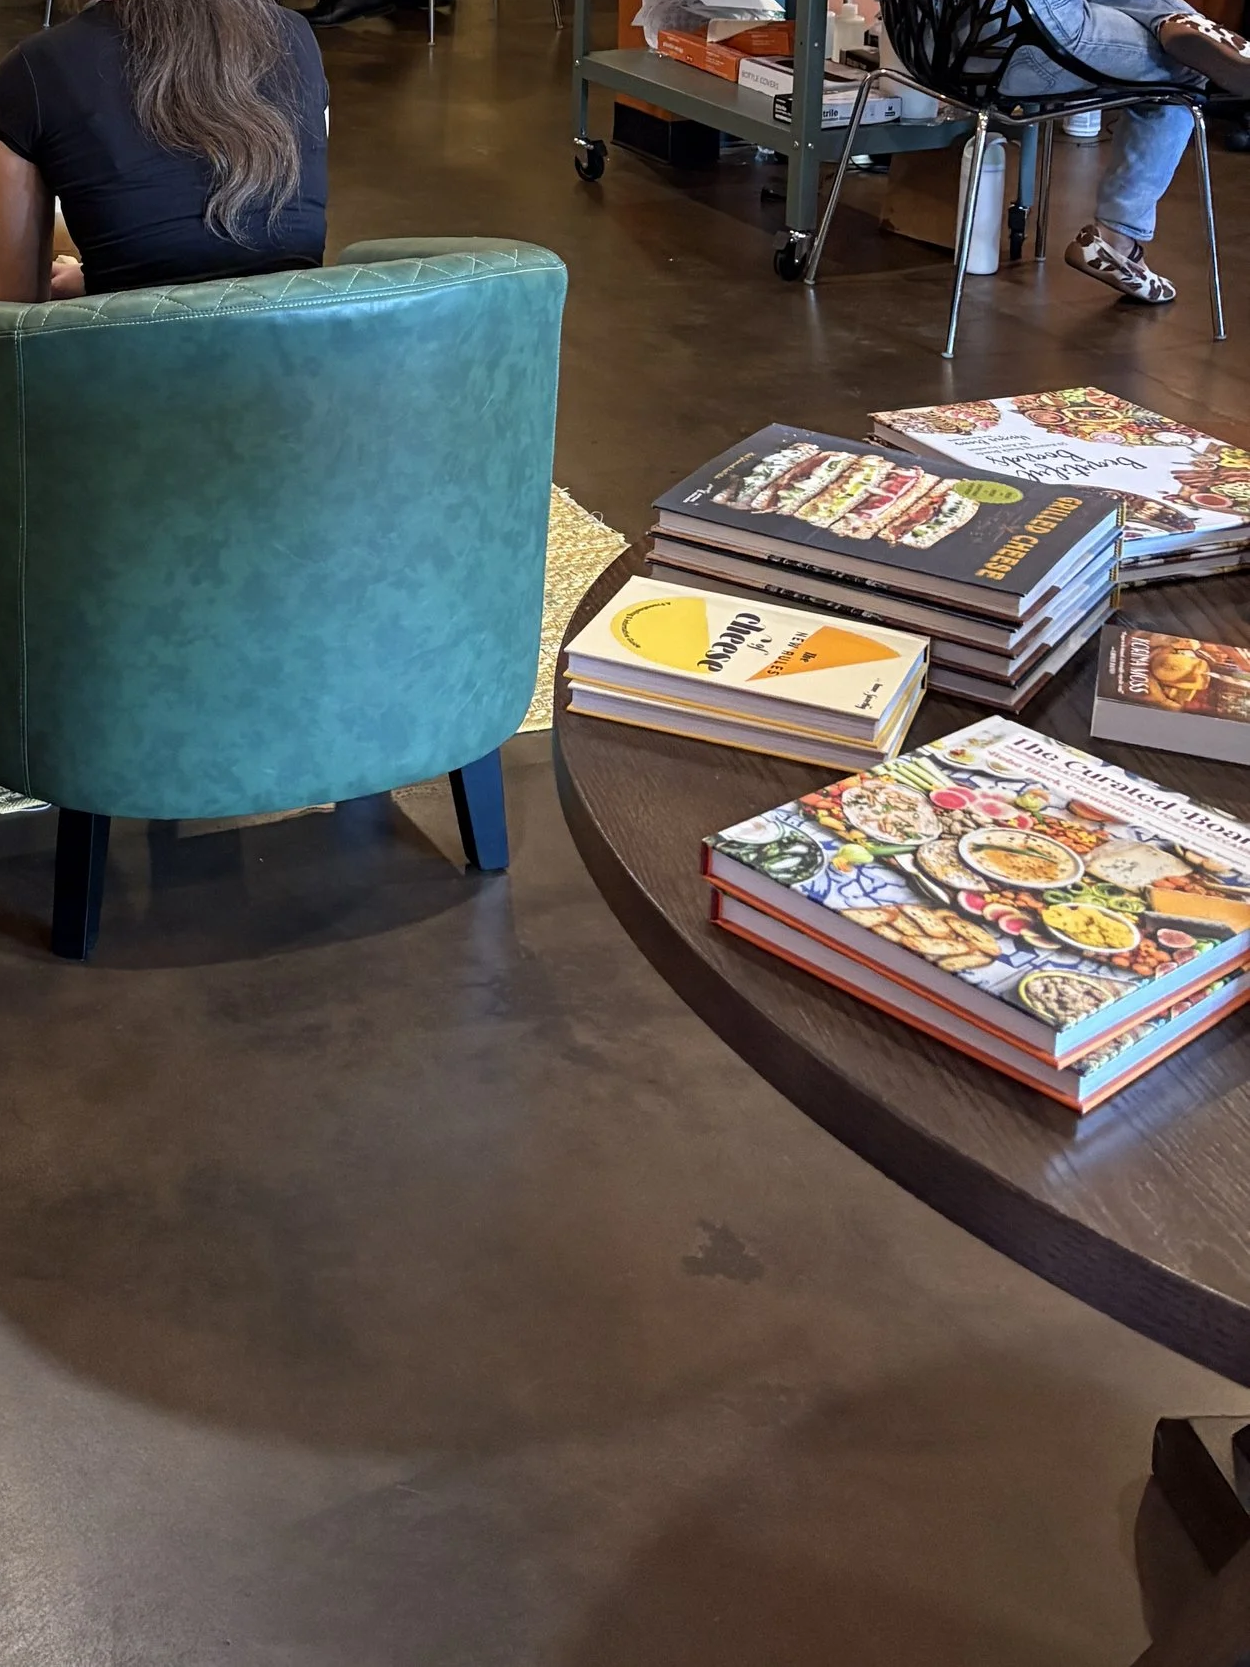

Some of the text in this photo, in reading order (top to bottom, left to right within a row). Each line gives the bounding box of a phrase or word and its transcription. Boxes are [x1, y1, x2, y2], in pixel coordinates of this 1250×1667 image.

[822, 108, 839, 118] trile
[986, 449, 1087, 467] Boards
[1016, 456, 1148, 483] Beautiful
[974, 496, 1085, 581] GRILLED CHEESE
[696, 612, 766, 673] cheese
[745, 634, 773, 657] of
[766, 630, 810, 677] NEW RULES
[799, 650, 819, 664] The
[1128, 667, 1150, 694] MOSS
[1012, 735, 1250, 845] The Curated Boar
